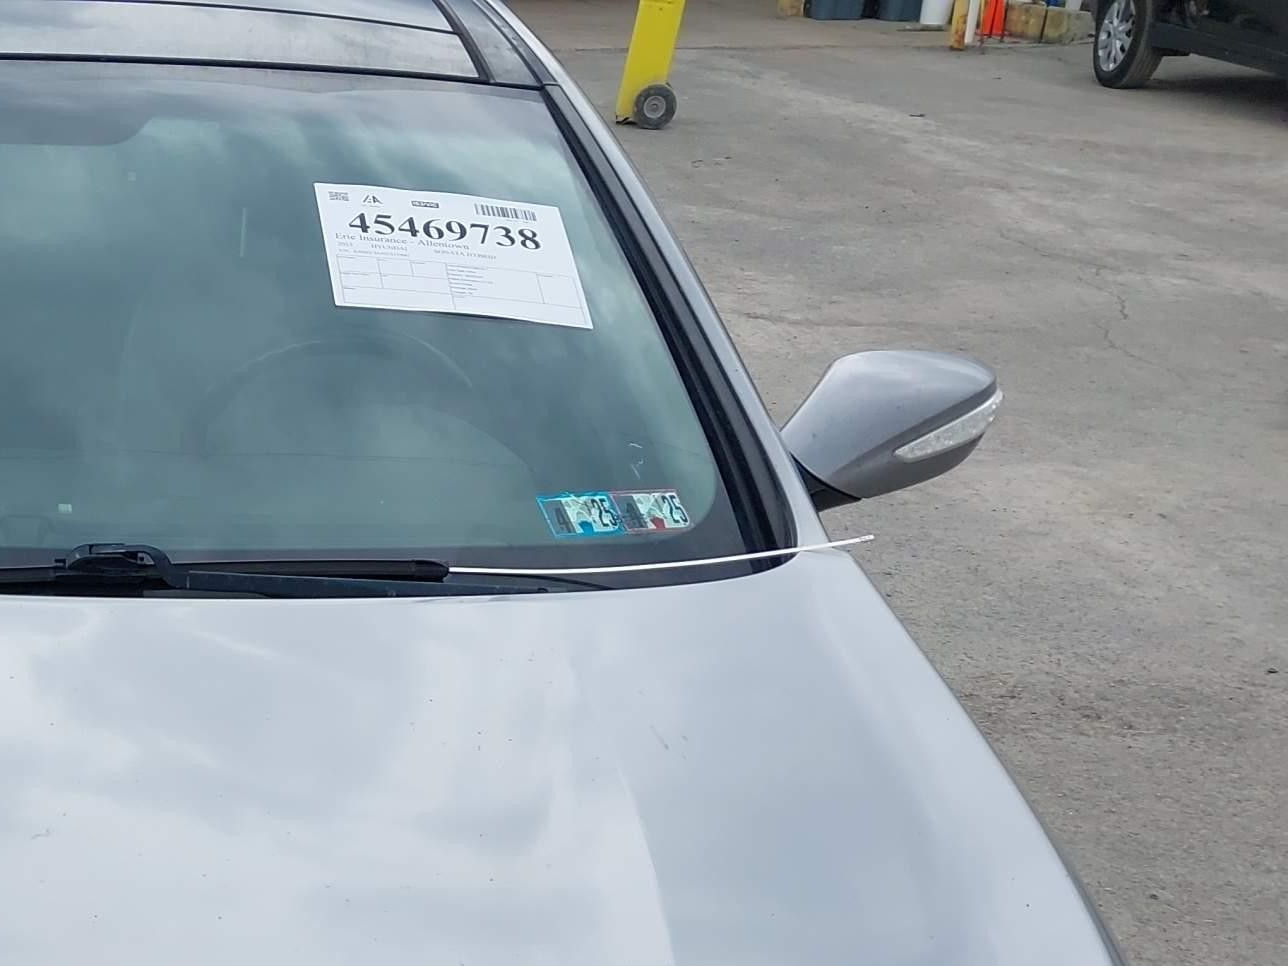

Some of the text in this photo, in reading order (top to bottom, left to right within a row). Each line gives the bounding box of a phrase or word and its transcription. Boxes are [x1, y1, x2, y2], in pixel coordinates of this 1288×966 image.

[335, 232, 357, 241] Erie
[359, 234, 408, 245] Insurance
[417, 239, 471, 250] Allentown
[348, 211, 542, 250] 45469738
[591, 498, 618, 528] 25
[661, 494, 689, 524] 25
